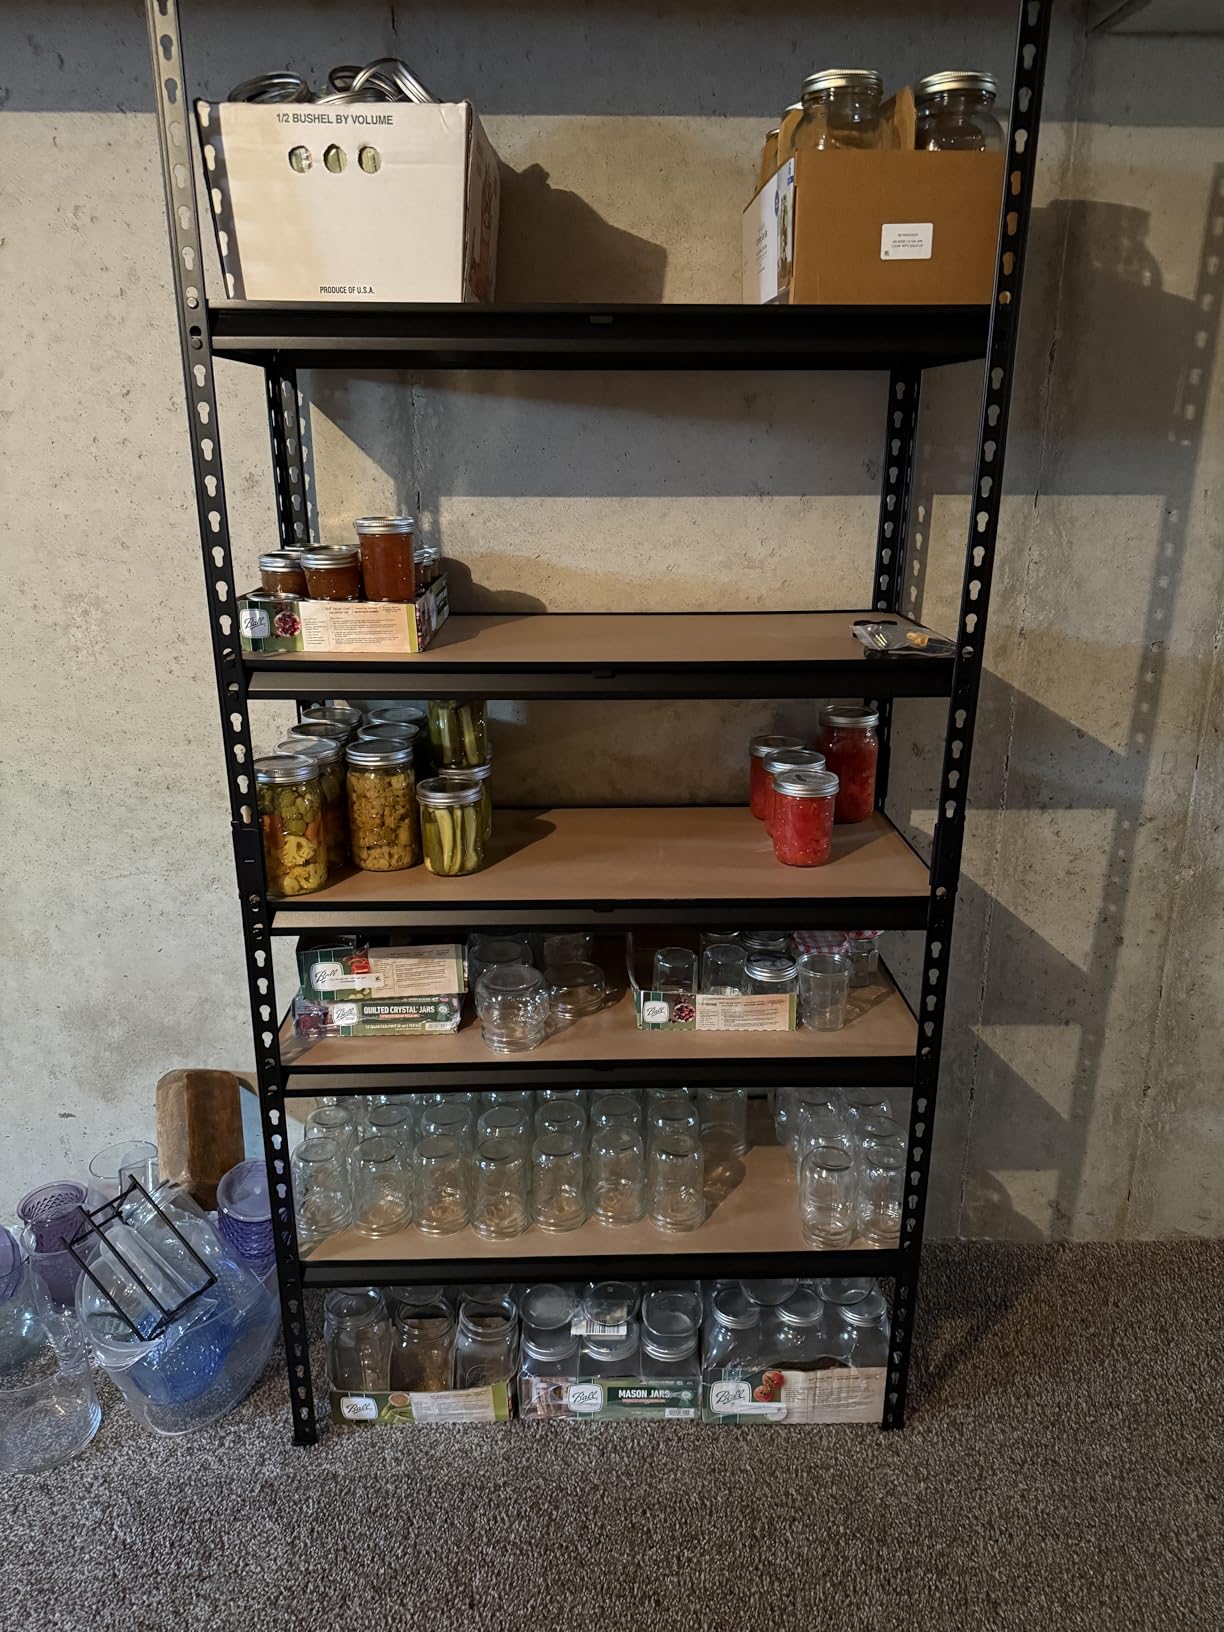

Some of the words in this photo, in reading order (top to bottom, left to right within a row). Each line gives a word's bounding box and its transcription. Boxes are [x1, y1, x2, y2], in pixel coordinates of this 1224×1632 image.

[276, 113, 290, 123] 1/2
[292, 113, 333, 124] BUSHEL
[335, 114, 349, 125] BY
[351, 114, 394, 125] VOLUME
[319, 286, 347, 294] PRODUCE
[348, 286, 356, 294] OF
[356, 286, 375, 294] U.S.A.
[244, 616, 267, 630] Ball
[315, 968, 338, 984] Ball
[335, 1007, 355, 1020] Ball
[363, 1006, 389, 1015] QUILTED
[419, 1005, 435, 1014] JARS
[646, 1006, 665, 1018] Ball
[572, 1390, 599, 1404] Ball
[618, 1389, 647, 1399] MASON
[649, 1389, 670, 1399] JARS
[715, 1389, 746, 1405] Ball
[345, 1402, 373, 1415] Ball
